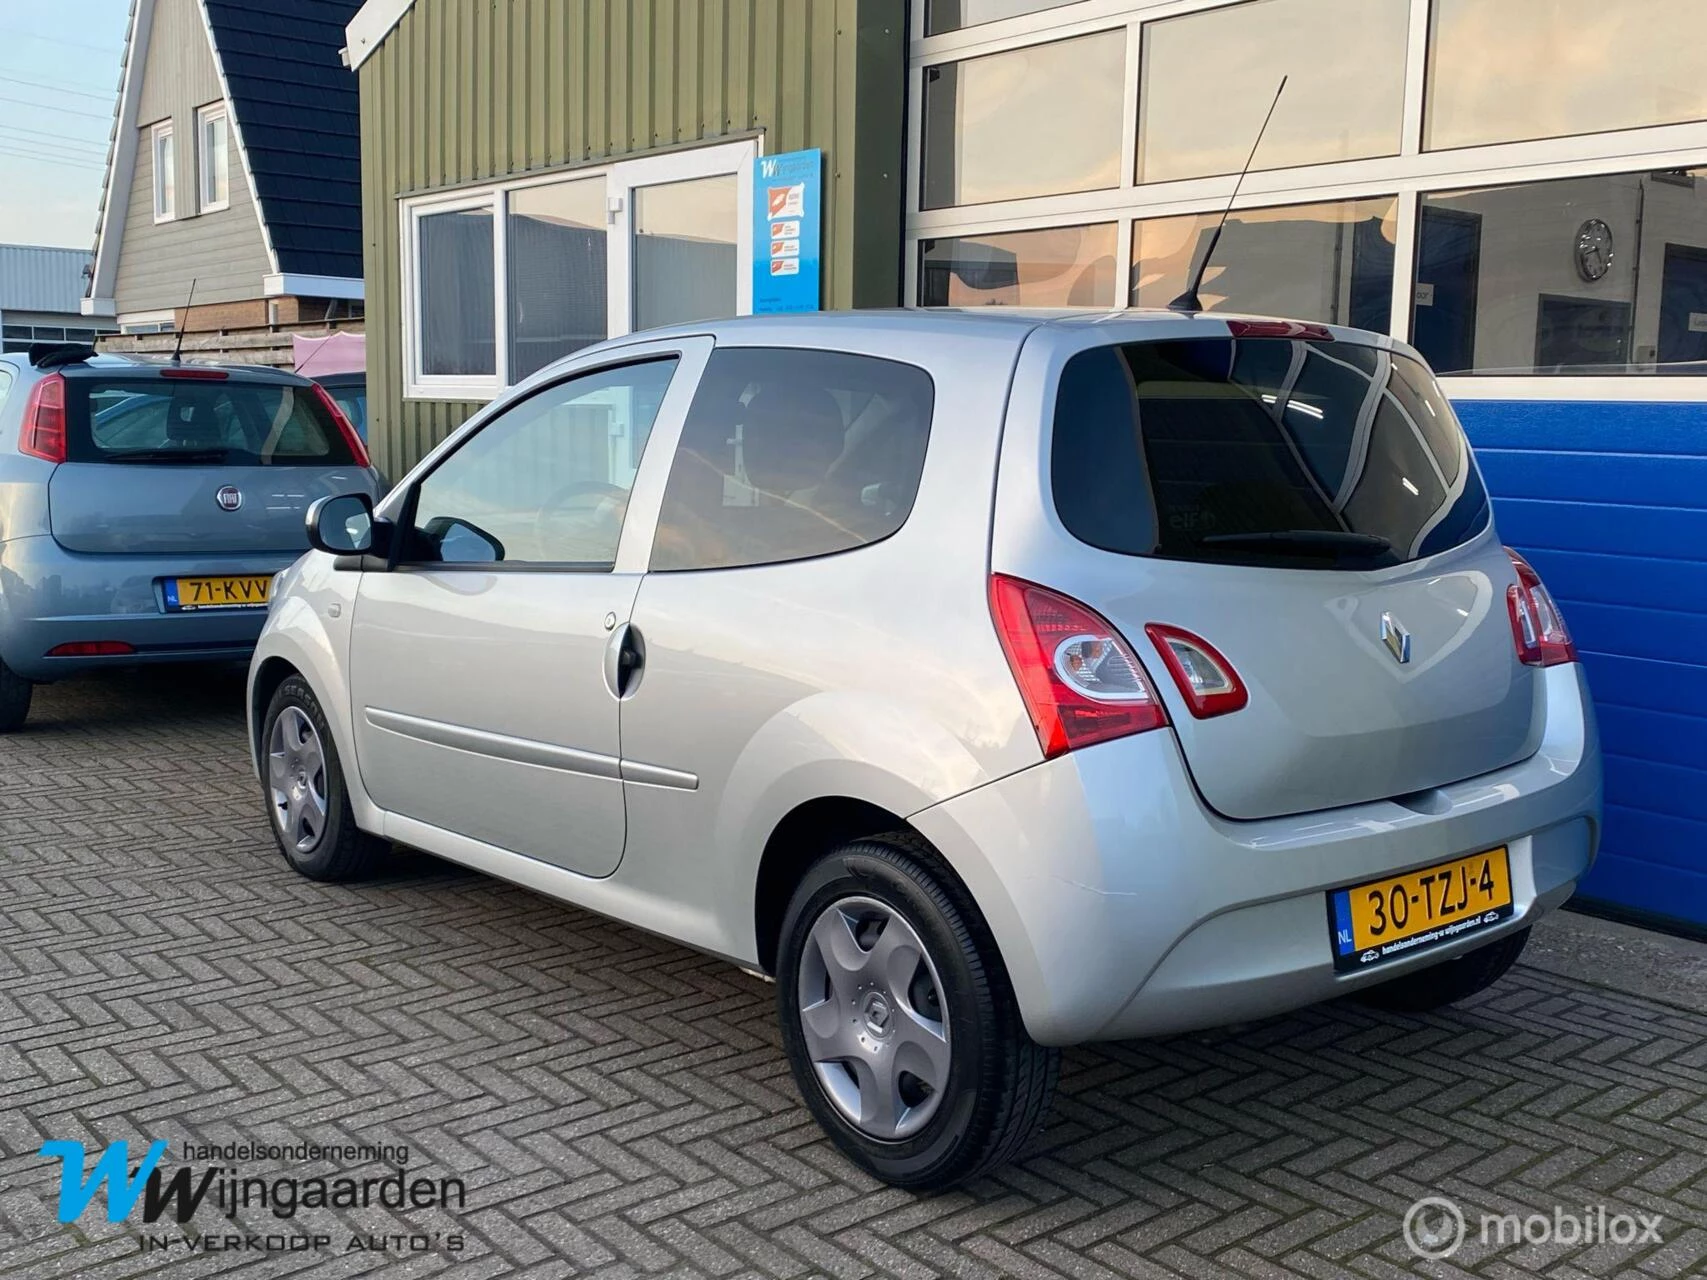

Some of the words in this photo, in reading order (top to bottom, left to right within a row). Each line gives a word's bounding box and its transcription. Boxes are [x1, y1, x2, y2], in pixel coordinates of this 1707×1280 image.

[223, 493, 237, 503] FIAT
[1367, 859, 1494, 936] 30-TZJ-4
[1337, 930, 1352, 944] NL
